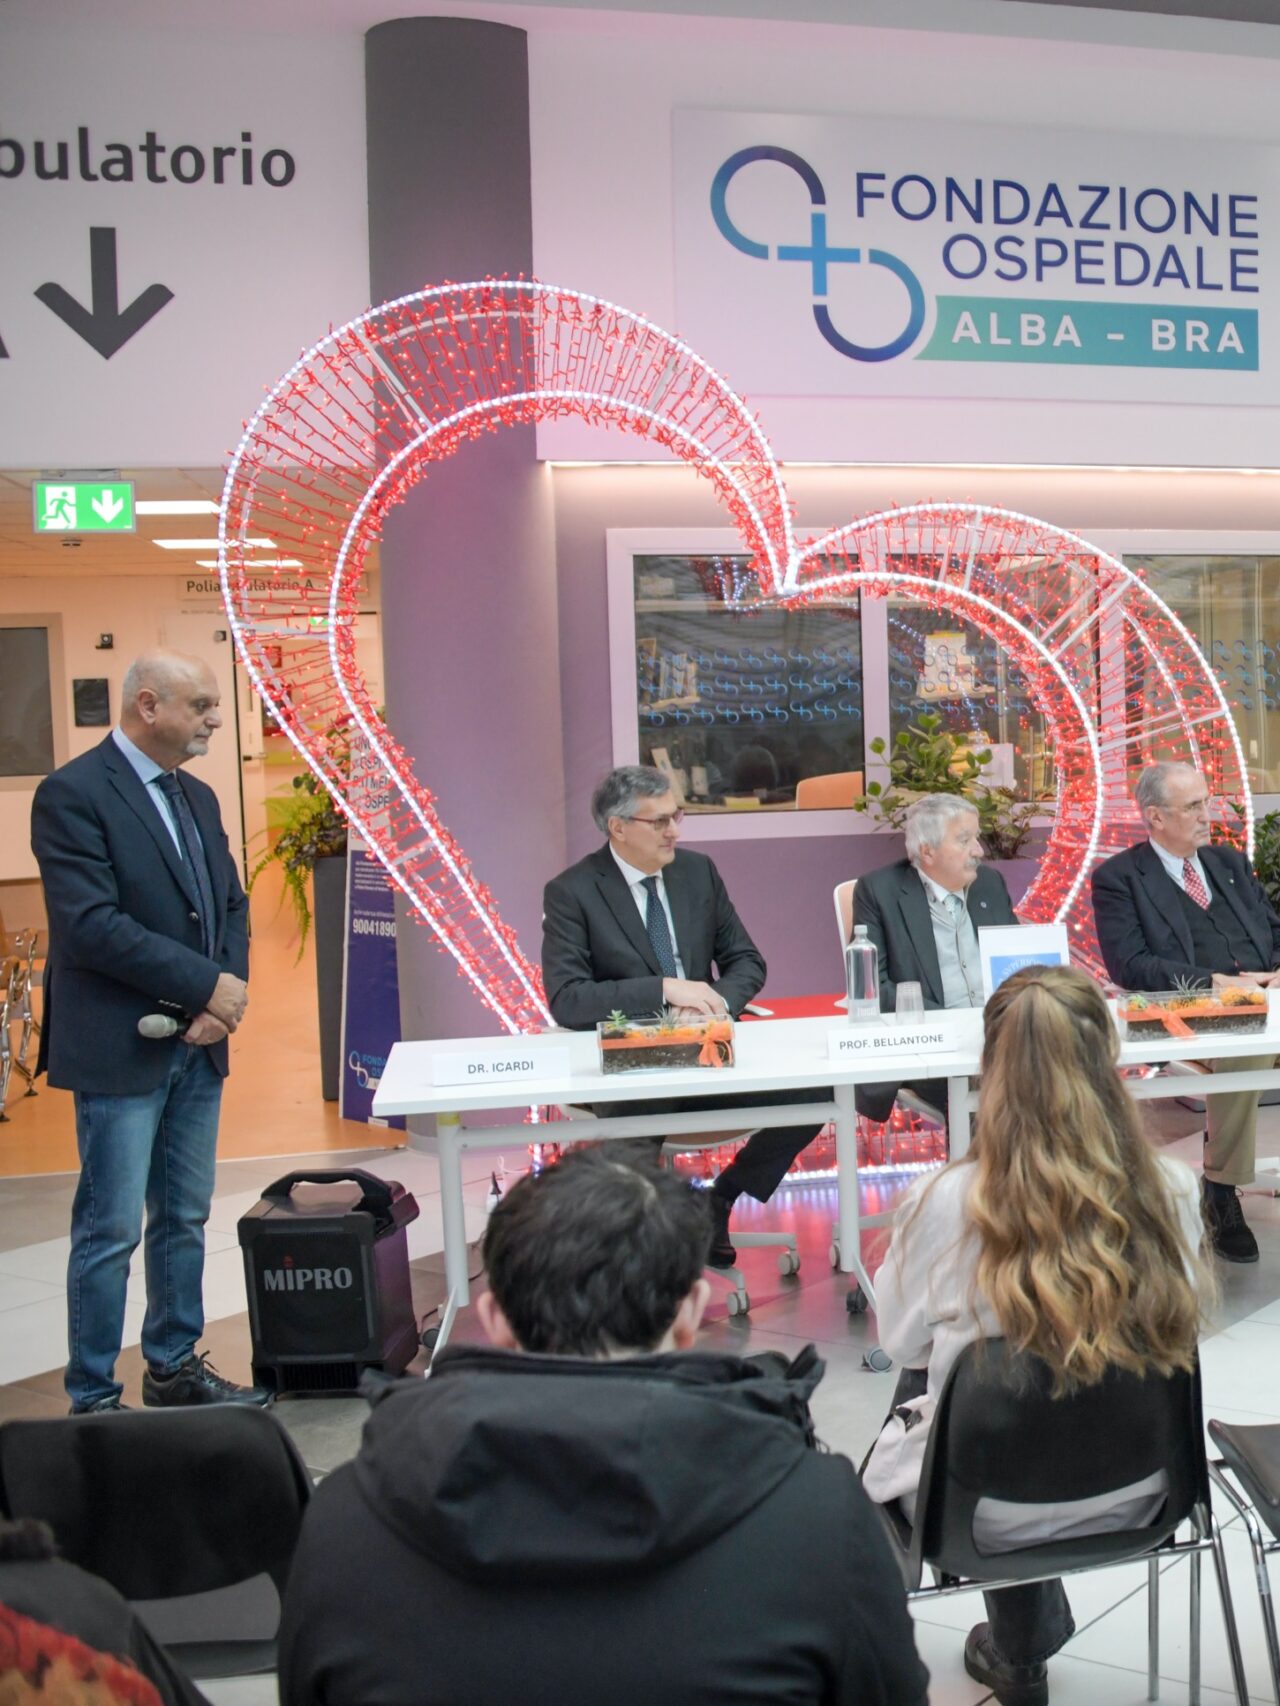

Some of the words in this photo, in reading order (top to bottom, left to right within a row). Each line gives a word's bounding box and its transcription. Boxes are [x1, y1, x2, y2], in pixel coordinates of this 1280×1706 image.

[855, 172, 1259, 238] FONDAZIONE
[941, 233, 1260, 293] OSPEDALE
[951, 311, 1083, 348] ALBA
[1151, 319, 1246, 354] BRA
[839, 1039, 871, 1050] PROF.
[873, 1034, 944, 1048] BELLANTONE
[467, 1063, 489, 1074] DR.
[492, 1060, 534, 1073] ICARDI
[263, 1267, 353, 1291] MIPRO
